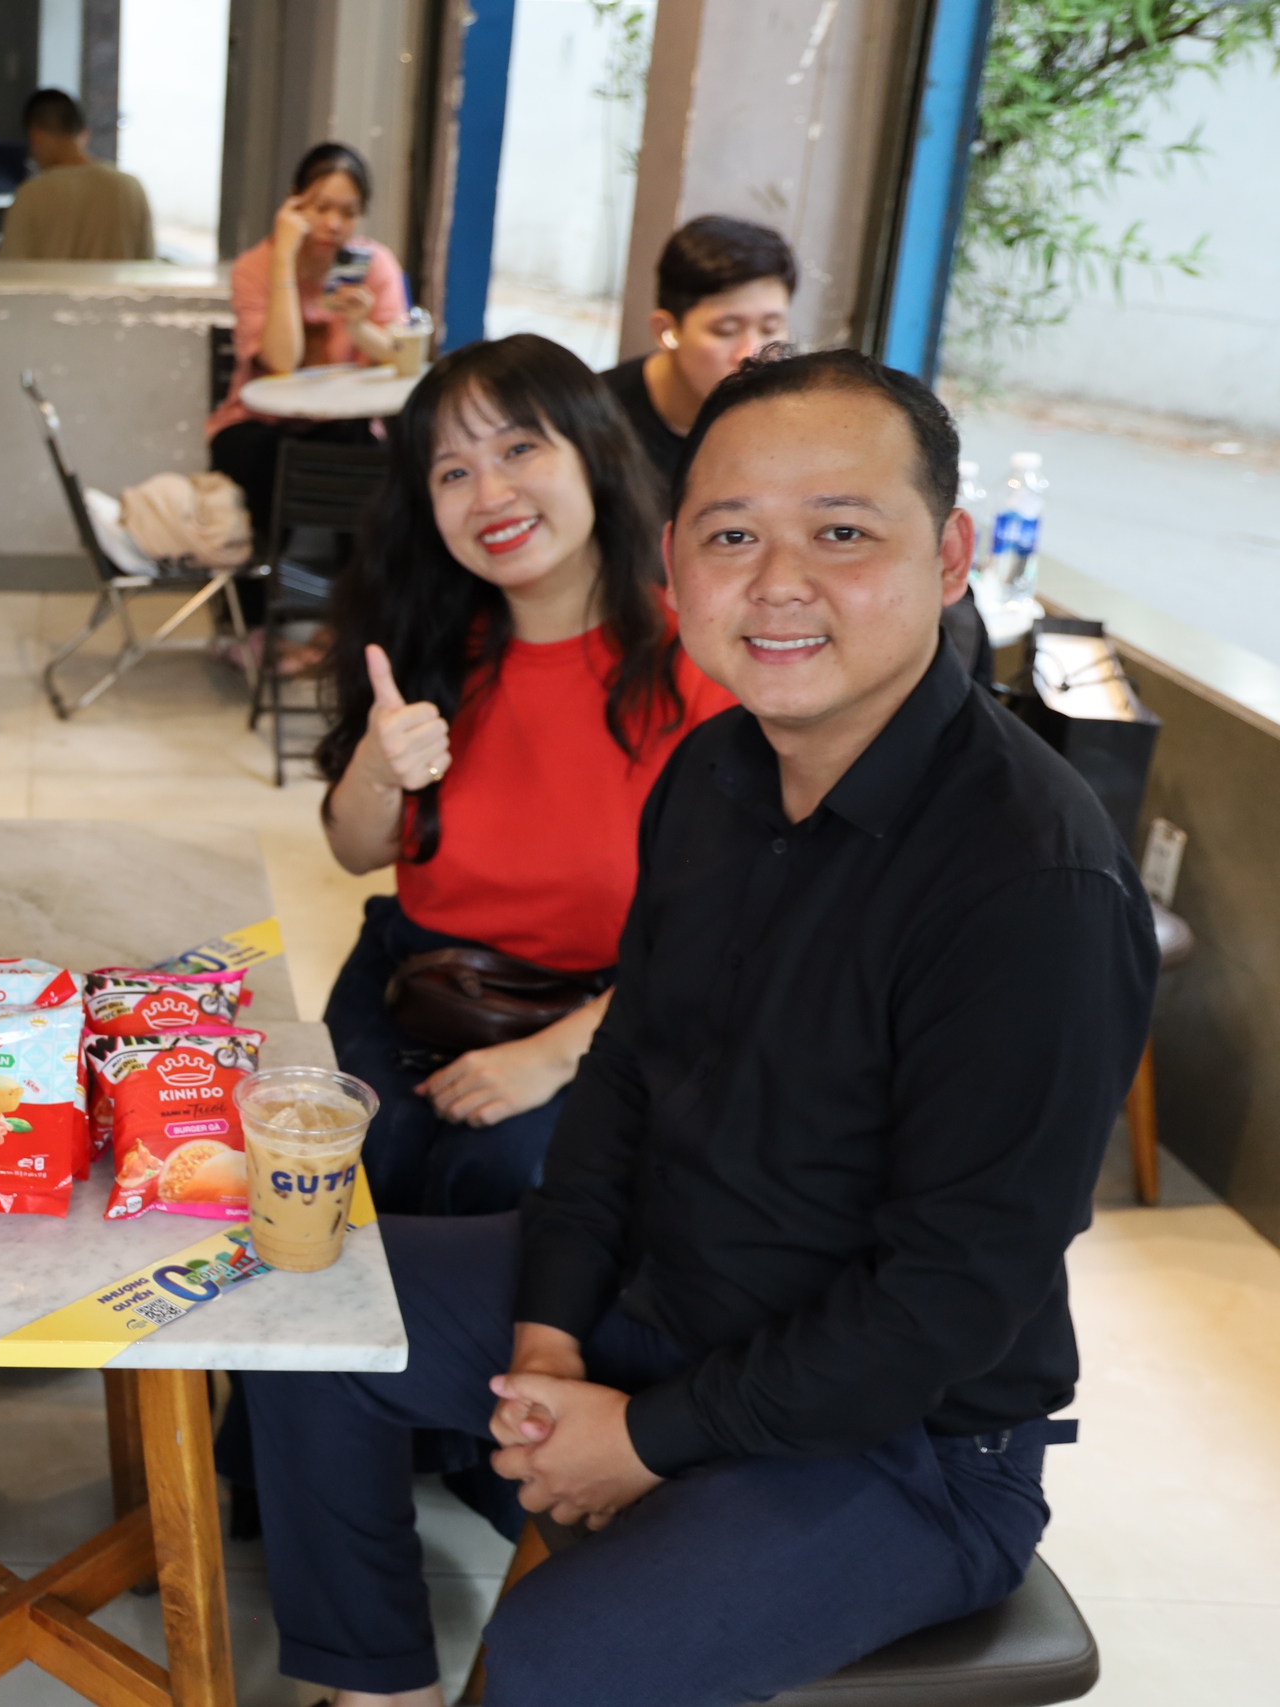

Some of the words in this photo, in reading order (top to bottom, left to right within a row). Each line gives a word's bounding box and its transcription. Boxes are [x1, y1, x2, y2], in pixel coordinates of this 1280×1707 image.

[159, 1087, 198, 1102] KINH
[200, 1086, 224, 1099] DO
[173, 1124, 208, 1134] BURGER
[271, 1164, 357, 1194] GUTA
